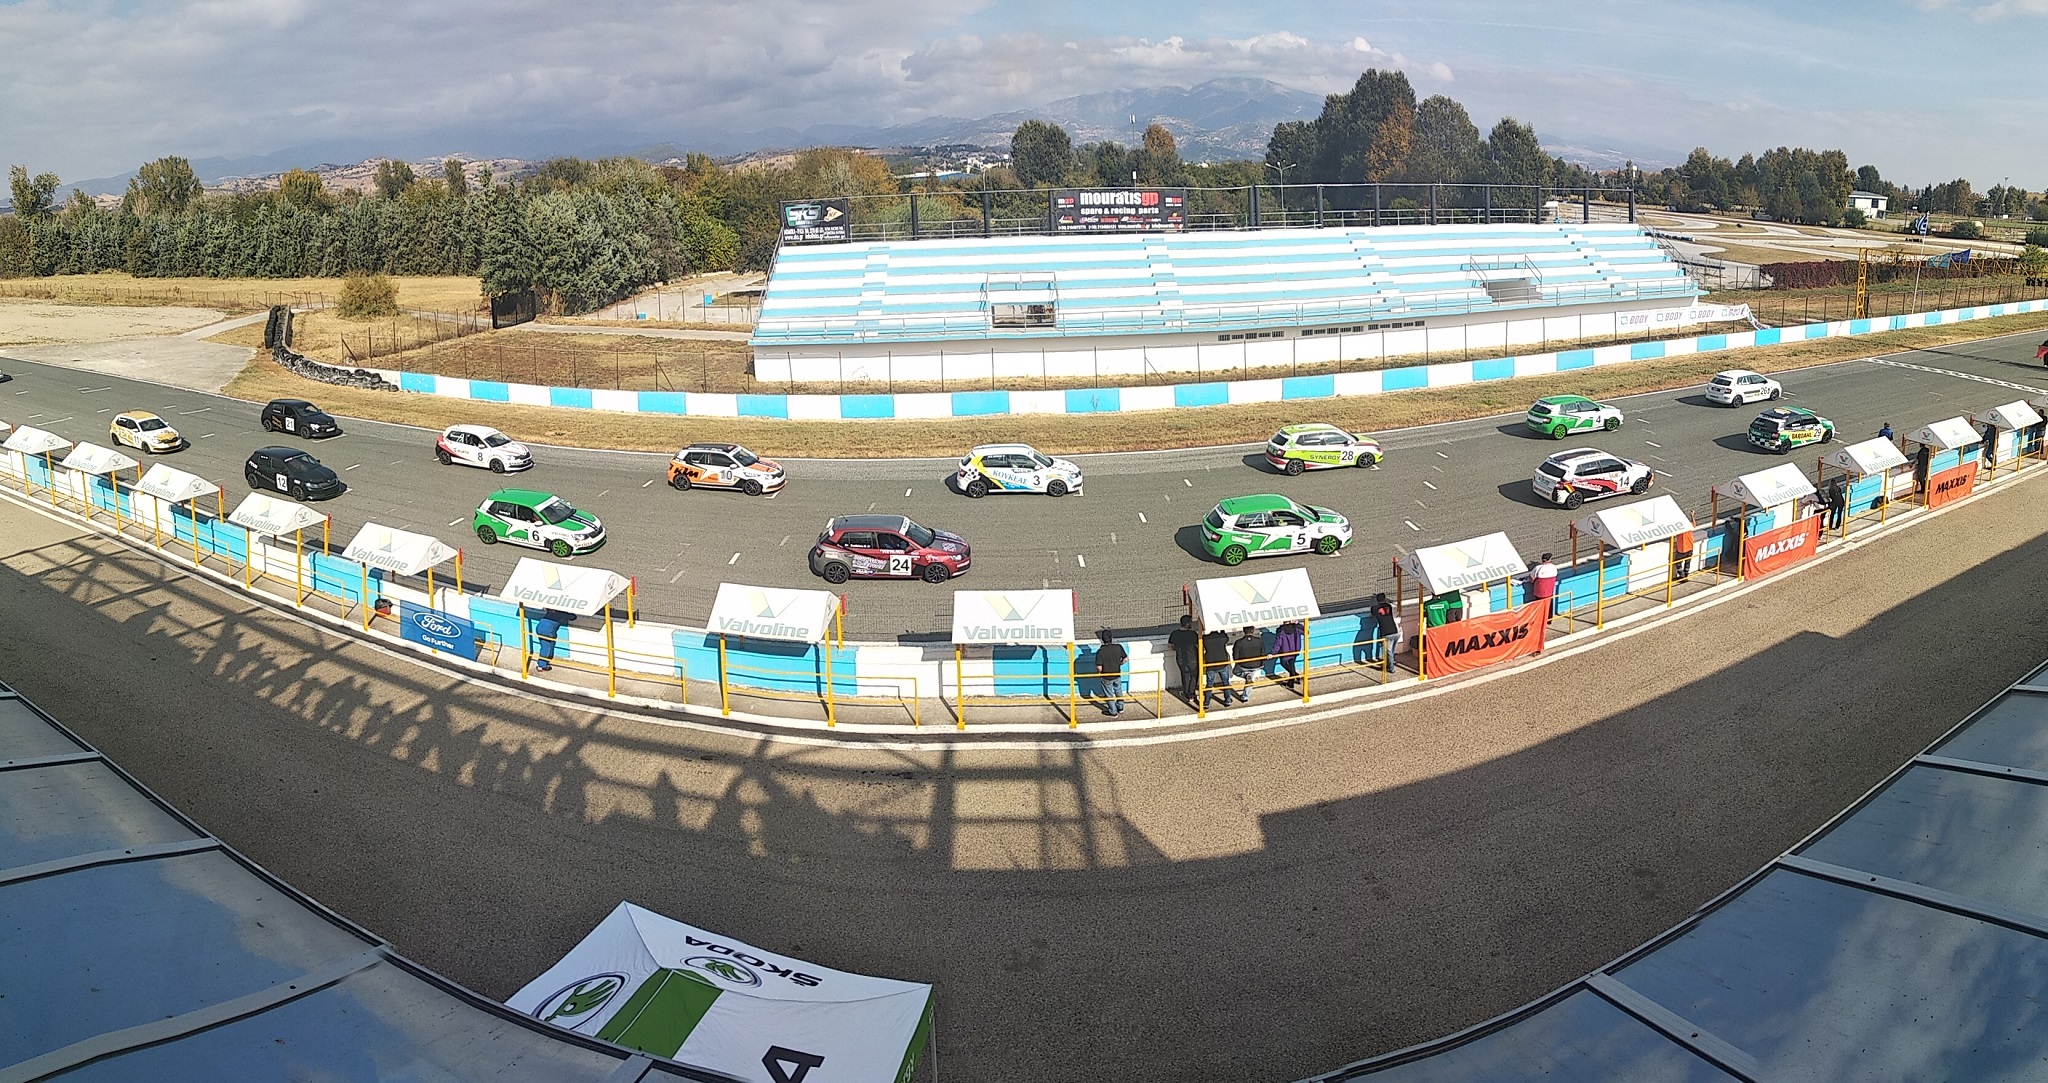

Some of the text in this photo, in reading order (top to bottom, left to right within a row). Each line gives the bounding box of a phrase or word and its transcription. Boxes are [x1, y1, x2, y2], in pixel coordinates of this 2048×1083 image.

[1079, 191, 1158, 206] mouratisgp
[1080, 208, 1102, 216] spare
[1111, 207, 1136, 216] racing
[1138, 207, 1160, 216] parts
[1629, 314, 1648, 325] BODY
[1665, 312, 1682, 322] BODY
[1697, 310, 1715, 320] BODY
[286, 419, 293, 429] 21
[1596, 415, 1601, 424] 4
[1814, 428, 1822, 437] 29
[478, 452, 484, 462] 8
[1310, 453, 1341, 461] SYNERGY
[1341, 450, 1354, 461] 28
[1866, 456, 1904, 472] Valvoline
[673, 466, 699, 479] KTM
[720, 470, 733, 481] 10
[277, 477, 286, 488] 12
[1033, 475, 1041, 486] 3
[1619, 476, 1630, 487] 14
[1935, 476, 1968, 494] MAXXIS
[141, 481, 176, 499] Valvoline
[1762, 482, 1810, 504] Valvoline
[236, 511, 282, 533] Valvoline
[531, 530, 540, 541] 6
[1620, 520, 1685, 544] Valvoline
[1296, 533, 1306, 545] 5
[1755, 534, 1806, 563] MAXXIS
[351, 546, 409, 571] Valvoline
[892, 559, 910, 572] 24
[1438, 562, 1517, 589] Valvoline
[514, 585, 589, 610] Valvoline
[1213, 604, 1310, 626] Valvoline
[421, 615, 452, 636] Ford
[719, 616, 810, 639] Valvoline
[963, 625, 1063, 640] Valvoline
[421, 633, 455, 650] Go Further
[1444, 623, 1529, 658] MAXXIS
